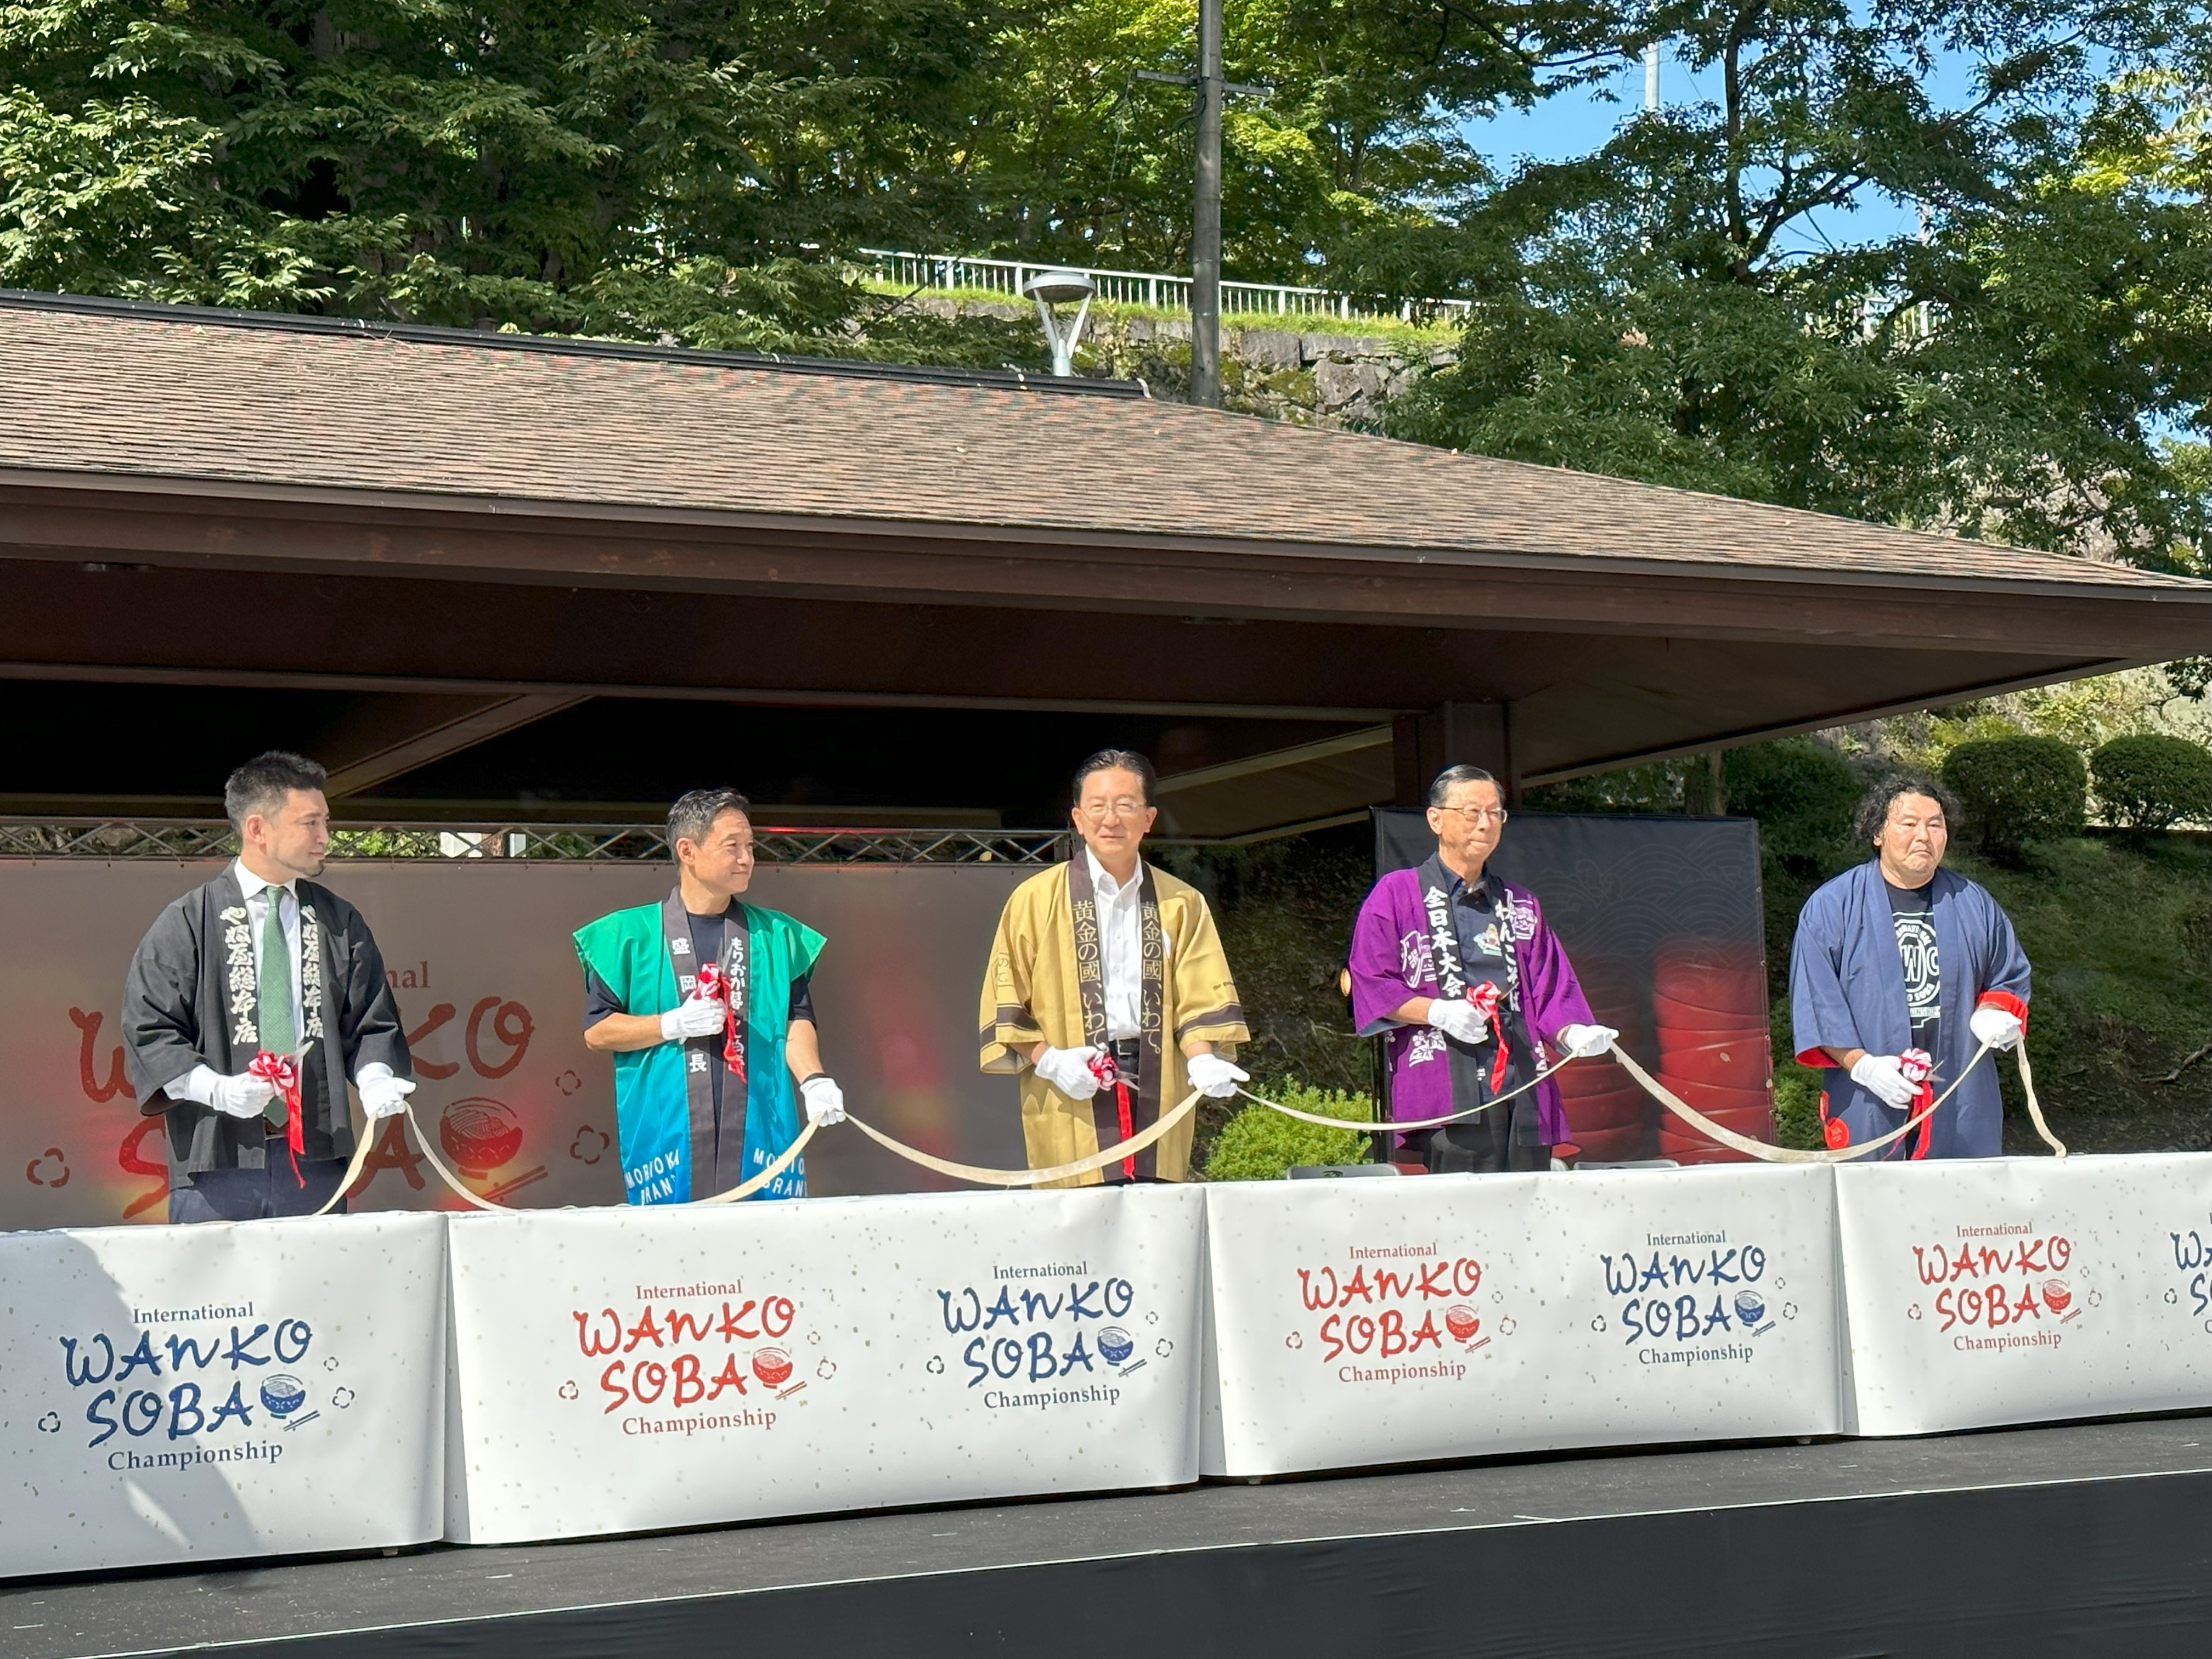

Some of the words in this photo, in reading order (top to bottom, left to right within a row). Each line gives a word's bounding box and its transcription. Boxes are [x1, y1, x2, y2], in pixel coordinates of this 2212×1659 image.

[1424, 885, 1466, 998] 全日本大会
[672, 937, 707, 1073] 盛岡長
[1349, 1243, 1437, 1259] International
[1646, 1230, 1725, 1246] International
[1957, 1222, 2032, 1238] International
[993, 1261, 1087, 1279] International
[1297, 1258, 1481, 1311] WANKO
[1600, 1245, 1766, 1295] WANKO
[1912, 1236, 2071, 1285] WANKO
[133, 1302, 253, 1323] International
[636, 1279, 741, 1299] International
[937, 1278, 1134, 1334] WANKO
[1936, 1284, 2040, 1333] SOBA
[573, 1296, 795, 1357] WANKO
[1321, 1310, 1442, 1363] SOBA
[1622, 1294, 1731, 1345] SOBA
[1954, 1330, 2061, 1352] Championship
[60, 1319, 313, 1386] WANKO
[964, 1331, 1093, 1388] SOBA
[1339, 1361, 1465, 1384] Championship
[1639, 1344, 1753, 1366] Championship
[601, 1353, 747, 1414] SOBA
[984, 1385, 1120, 1410] Championship
[87, 1381, 253, 1448] SOBA
[623, 1408, 776, 1436] Championship
[108, 1440, 283, 1471] Championship
